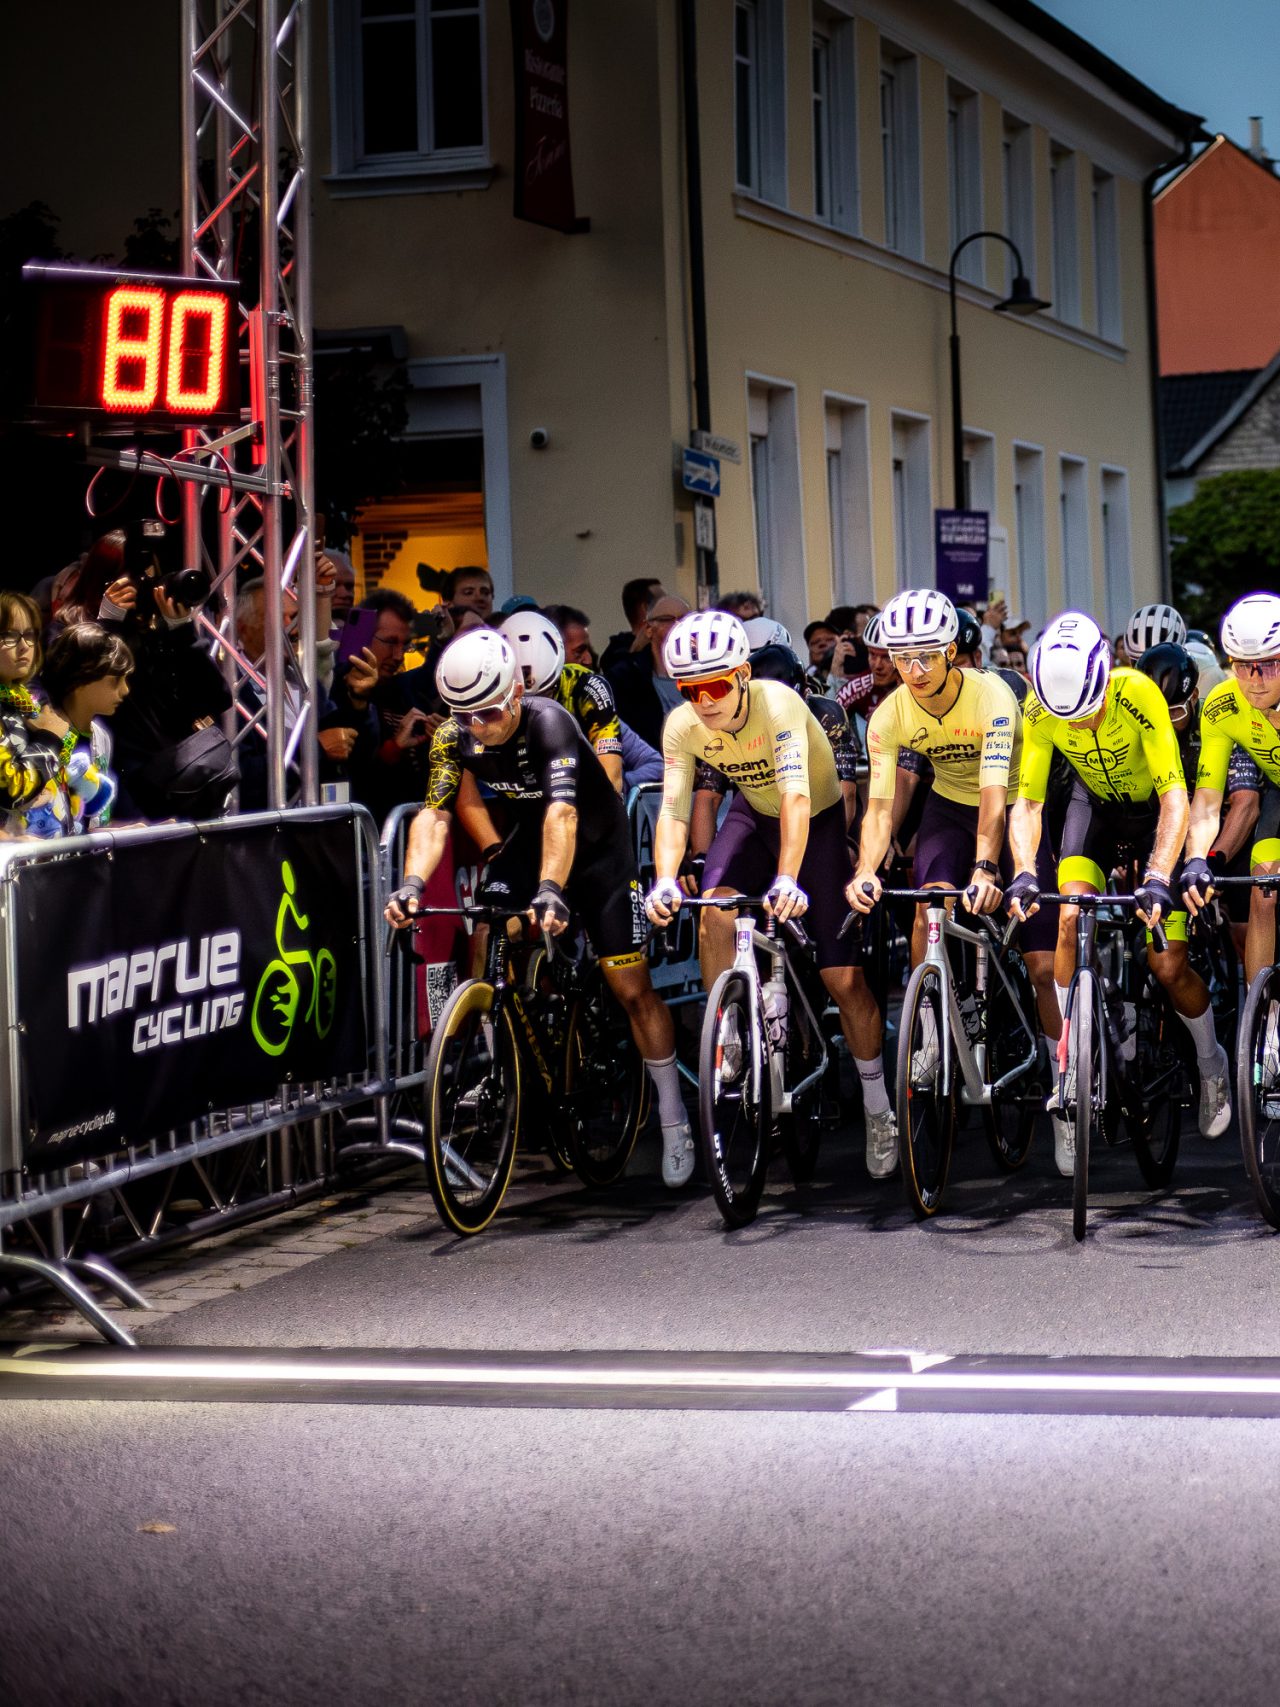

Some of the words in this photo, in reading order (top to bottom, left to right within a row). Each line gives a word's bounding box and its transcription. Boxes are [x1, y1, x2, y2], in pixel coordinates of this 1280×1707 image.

[102, 284, 229, 415] 80
[1120, 697, 1155, 731] GIANT
[718, 759, 769, 773] team
[1089, 756, 1114, 764] MNI
[630, 891, 642, 944] HEPCO
